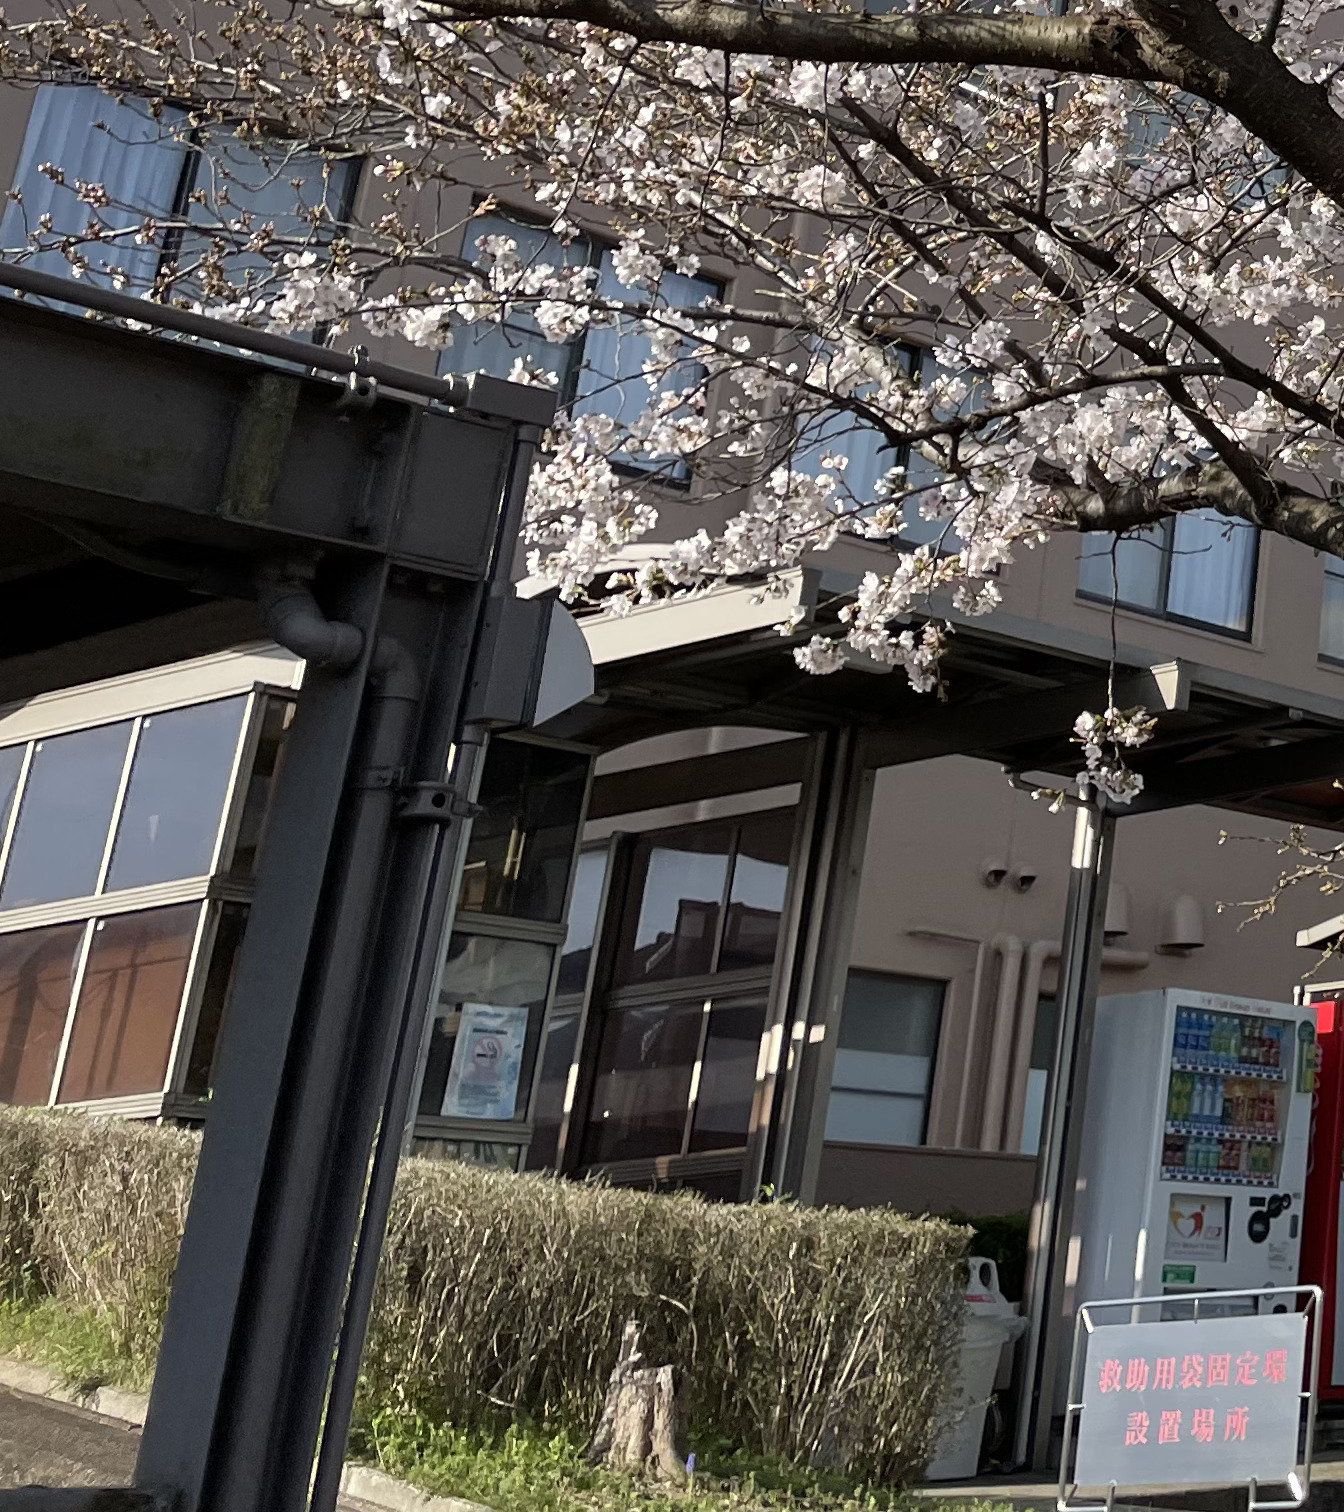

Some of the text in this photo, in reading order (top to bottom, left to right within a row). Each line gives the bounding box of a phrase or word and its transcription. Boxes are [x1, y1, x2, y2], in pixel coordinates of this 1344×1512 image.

[1098, 1349, 1289, 1394] 救助用袋固定環
[1123, 1405, 1250, 1447] 設置場所
